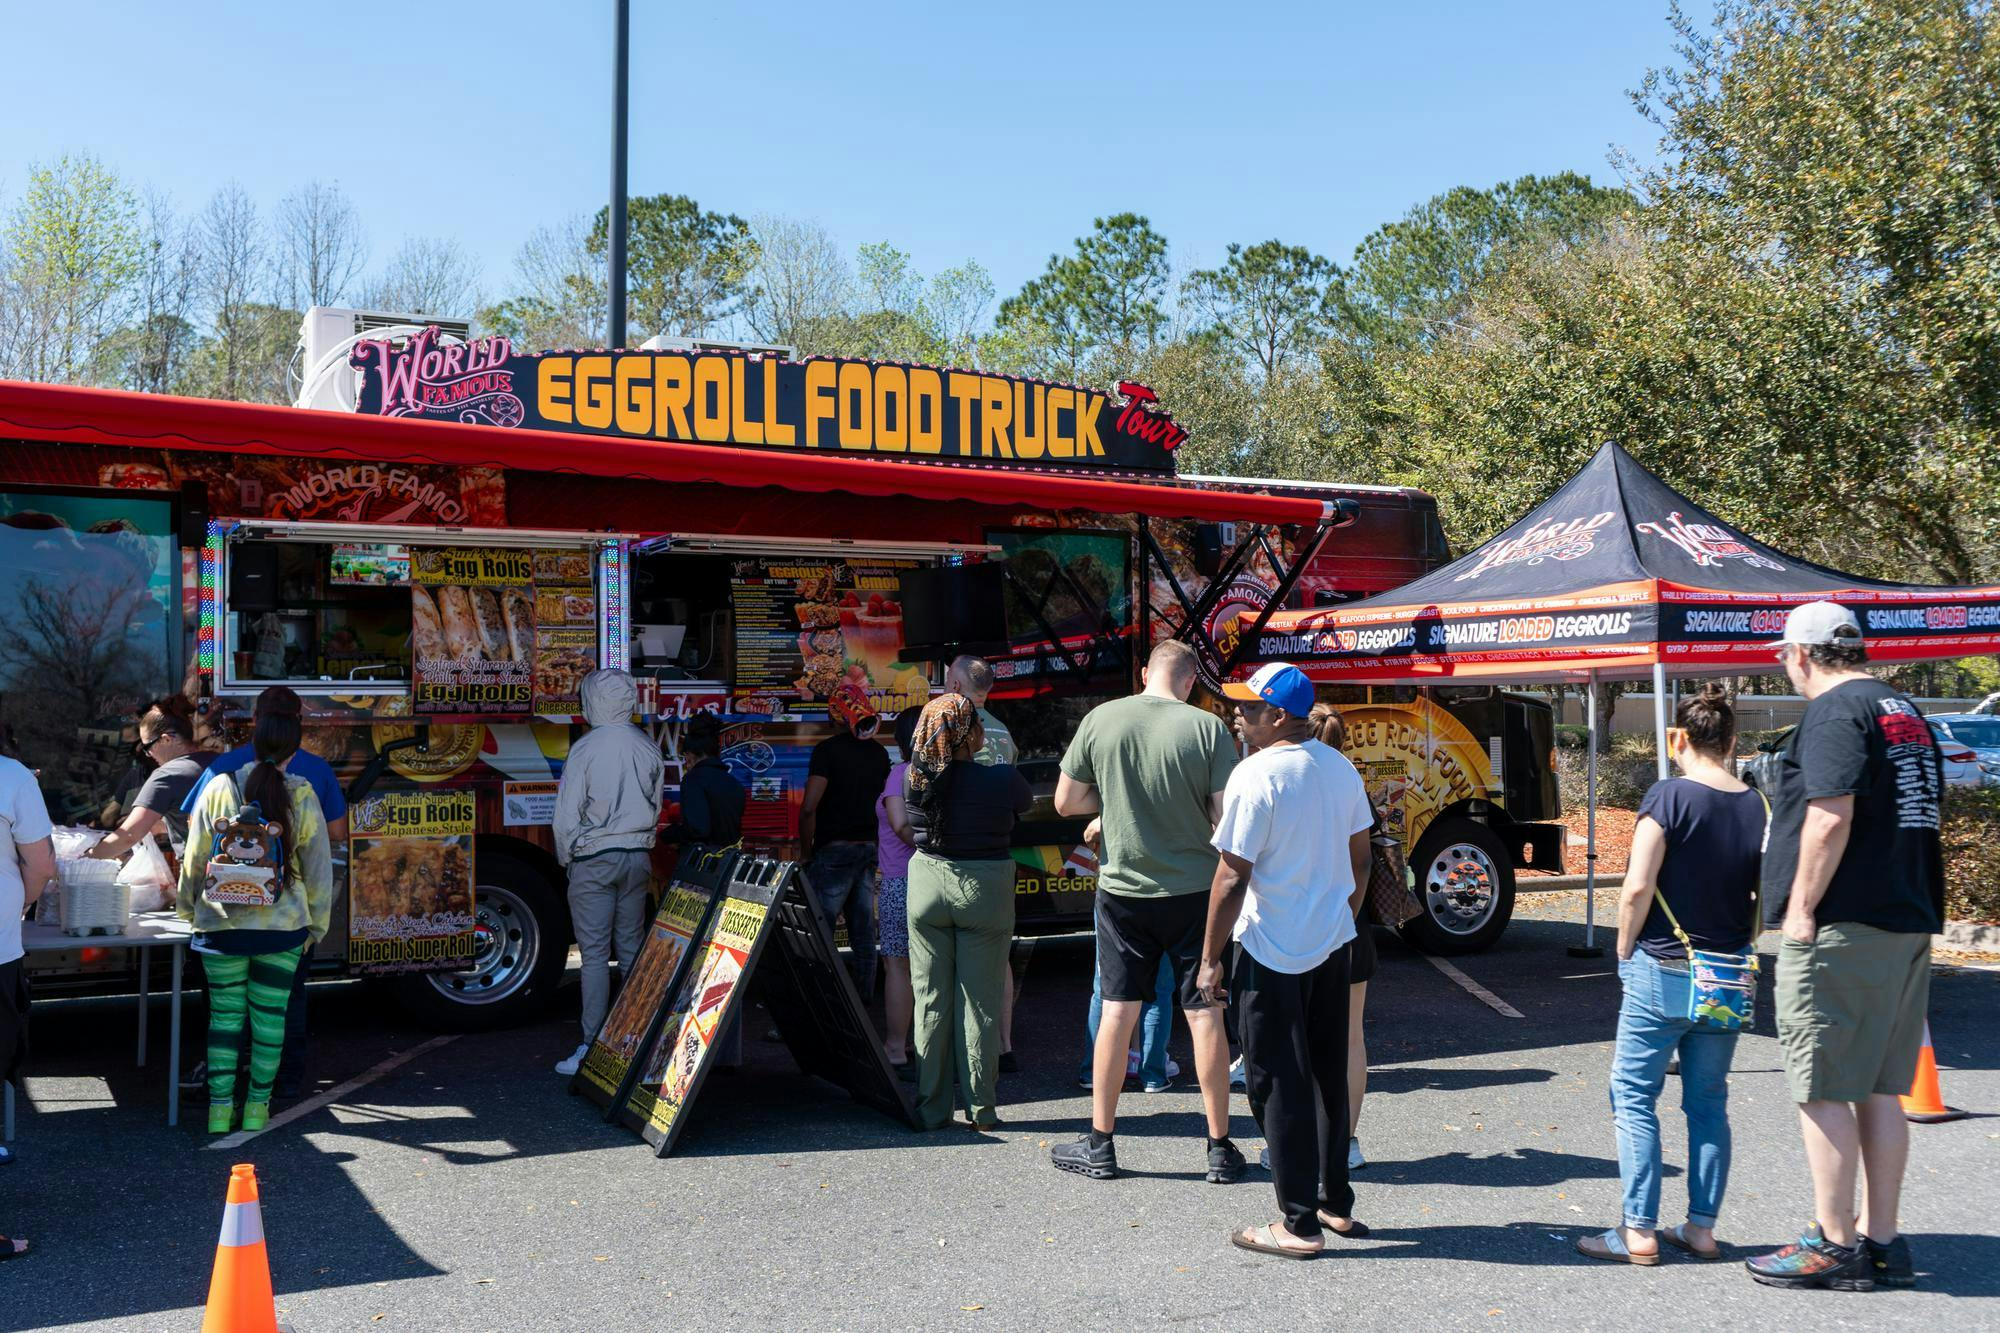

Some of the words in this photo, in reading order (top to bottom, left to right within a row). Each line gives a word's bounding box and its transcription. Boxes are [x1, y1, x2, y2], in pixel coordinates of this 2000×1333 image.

[354, 327, 509, 417] WORLD
[422, 374, 514, 405] FAMOUS
[537, 356, 796, 445] EGGROLL
[805, 358, 942, 454] FOOD
[948, 373, 1105, 457] TRUCK
[1115, 381, 1186, 450] Tour
[284, 465, 378, 511] WORLD
[1454, 512, 1615, 581] WORLD
[1636, 511, 1735, 567] WORLD
[444, 548, 477, 560] Surf
[495, 547, 526, 560] Turf
[445, 559, 479, 582] Egg
[484, 559, 532, 578] Rolls
[769, 566, 825, 579] EGGROLLS
[1684, 610, 1753, 633] SIGNATURE
[1866, 609, 1928, 630] SIGNATURE
[1926, 606, 1968, 630] LOADED
[1259, 632, 1314, 655] SIGNATURE
[1313, 630, 1358, 655] LOADED
[1358, 627, 1417, 649] EGGROLLS
[1429, 622, 1499, 645] SIGNATURE
[1497, 616, 1556, 644] LOADED
[1555, 612, 1632, 638] EGGROLLS
[1666, 644, 1689, 654] GYRO
[416, 654, 463, 671] Seafood
[465, 655, 515, 673] Supreme
[423, 670, 457, 690] Philly
[460, 670, 496, 685] Cheese
[497, 669, 532, 687] Steak
[418, 683, 466, 704] Egg
[467, 683, 533, 703] Rolls
[1343, 718, 1378, 751] EGG
[1384, 720, 1428, 761] ROLL
[1431, 745, 1476, 800] FOOD
[1378, 766, 1405, 776] DESSERTS
[385, 791, 423, 806] Hibachi
[425, 792, 452, 808] Super
[454, 790, 475, 804] Roll
[520, 784, 556, 793] WARNING
[387, 804, 421, 825] Egg
[426, 803, 474, 823] Rolls
[384, 825, 439, 838] Japanese
[442, 822, 471, 836] Style
[721, 909, 761, 941] DESSERTS
[350, 938, 404, 963] Hibachi
[405, 937, 447, 961] Super
[447, 934, 475, 957] Roll
